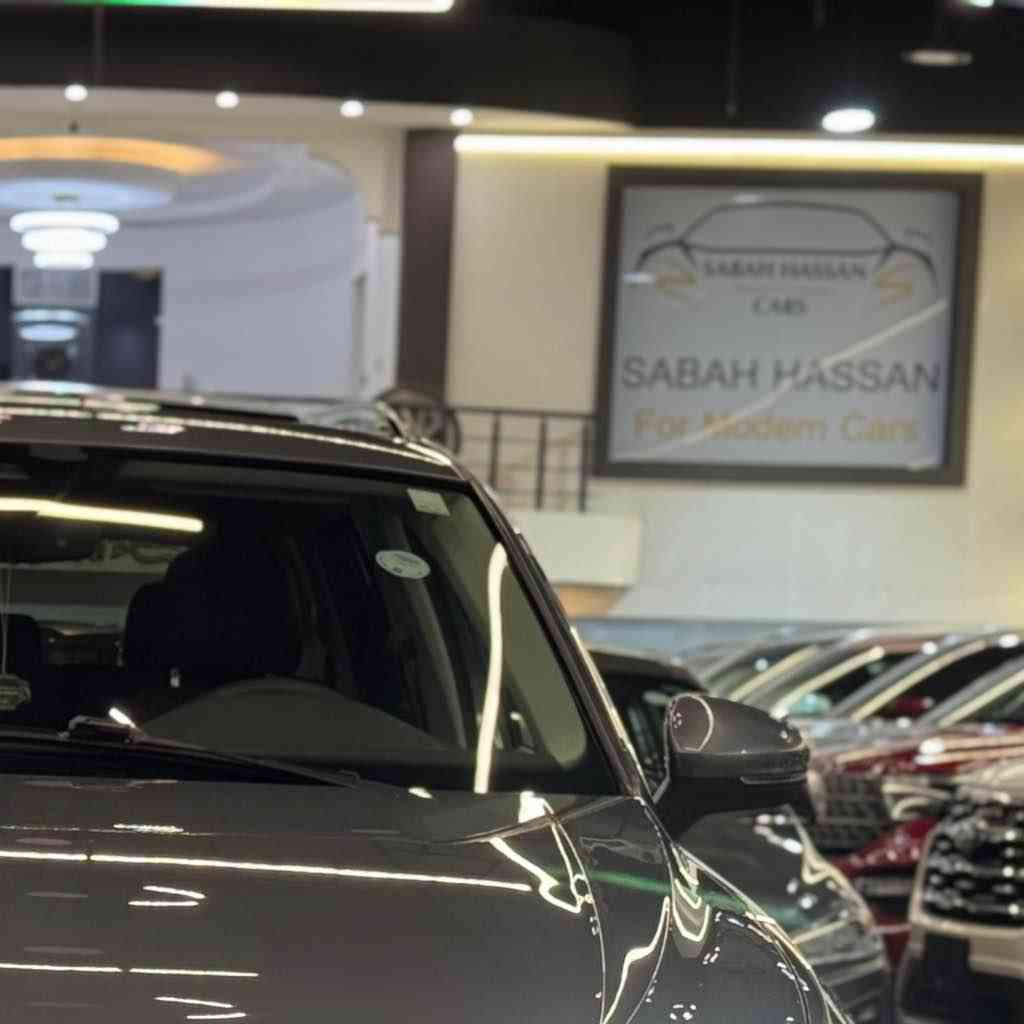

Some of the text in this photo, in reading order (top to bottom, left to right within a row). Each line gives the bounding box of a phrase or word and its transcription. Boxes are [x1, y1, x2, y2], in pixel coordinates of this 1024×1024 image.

[622, 355, 941, 394] SABAH HASSAN
[634, 407, 687, 439] For
[841, 412, 920, 443] Cars
